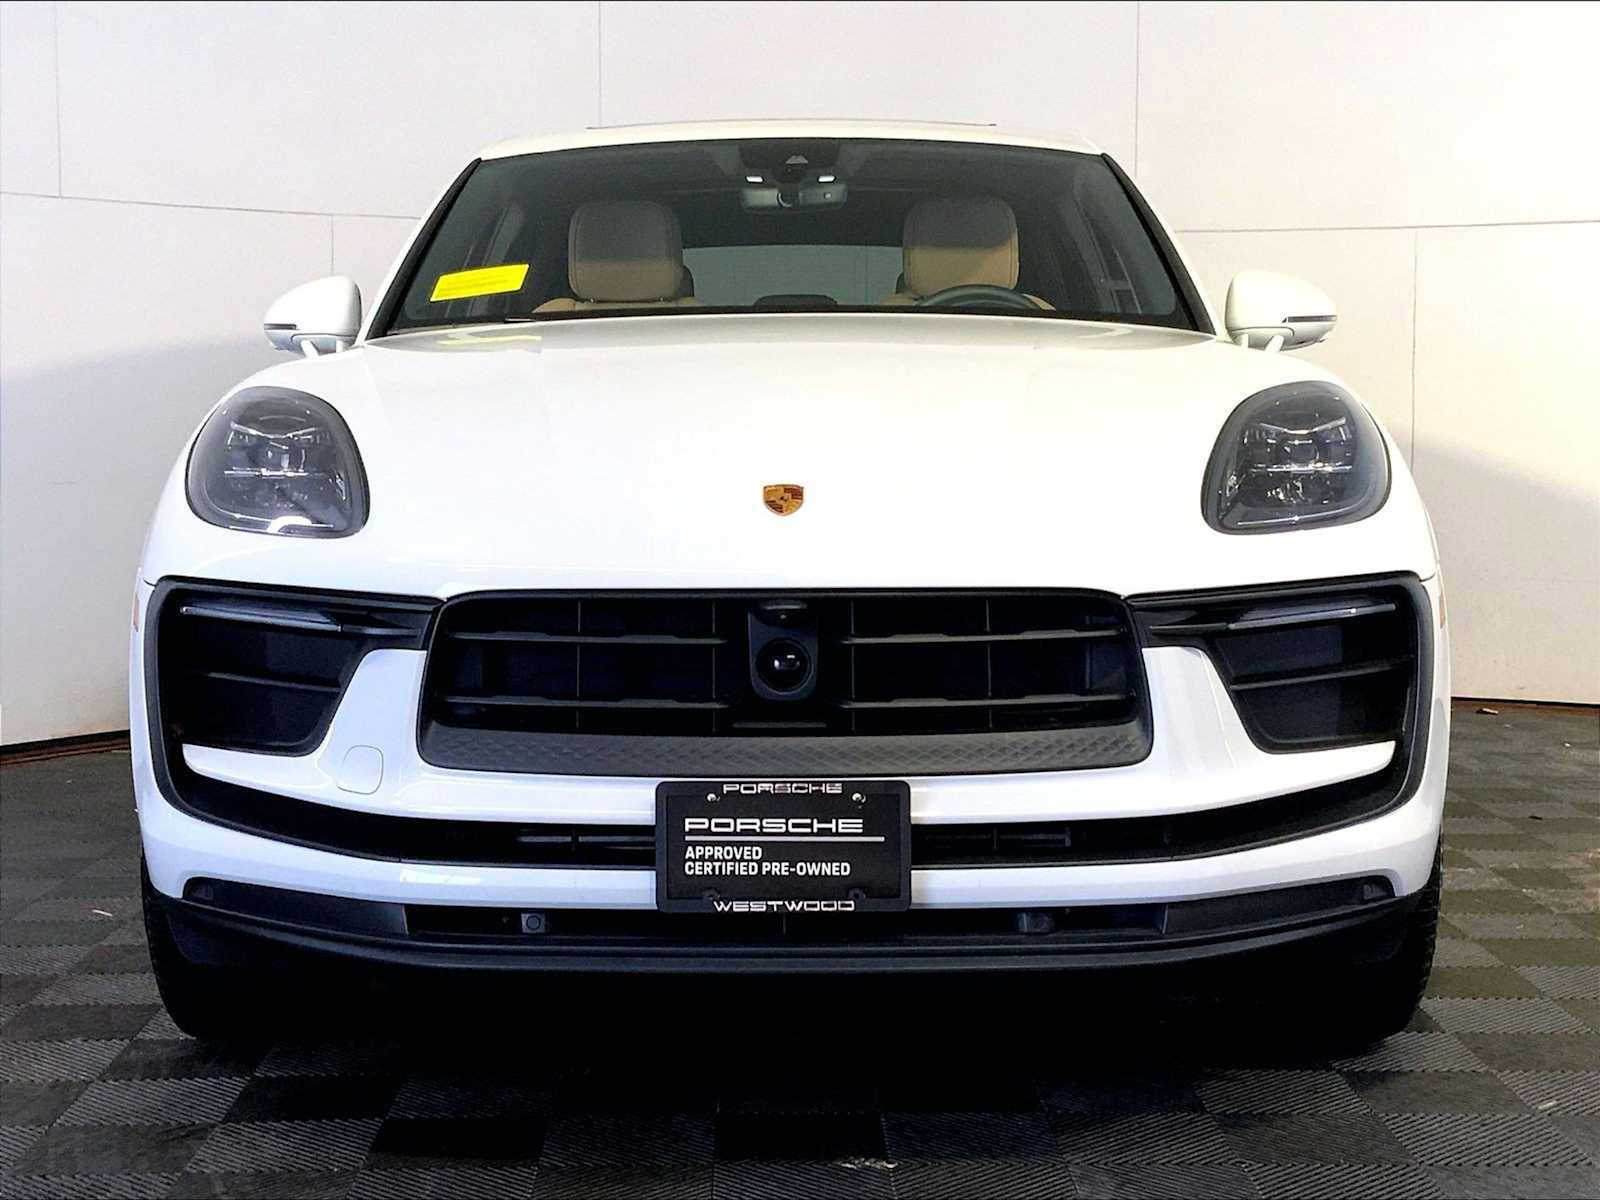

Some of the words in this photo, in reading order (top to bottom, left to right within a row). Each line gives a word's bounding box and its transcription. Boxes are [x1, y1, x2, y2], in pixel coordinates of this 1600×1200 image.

[723, 783, 843, 794] PORSCHE
[684, 818, 864, 833] PORSCHE
[685, 846, 762, 859] APPROVED
[684, 861, 758, 876] CERTIFIED
[762, 861, 851, 876] PRE-OWNED
[714, 900, 855, 912] WESTWOOD
